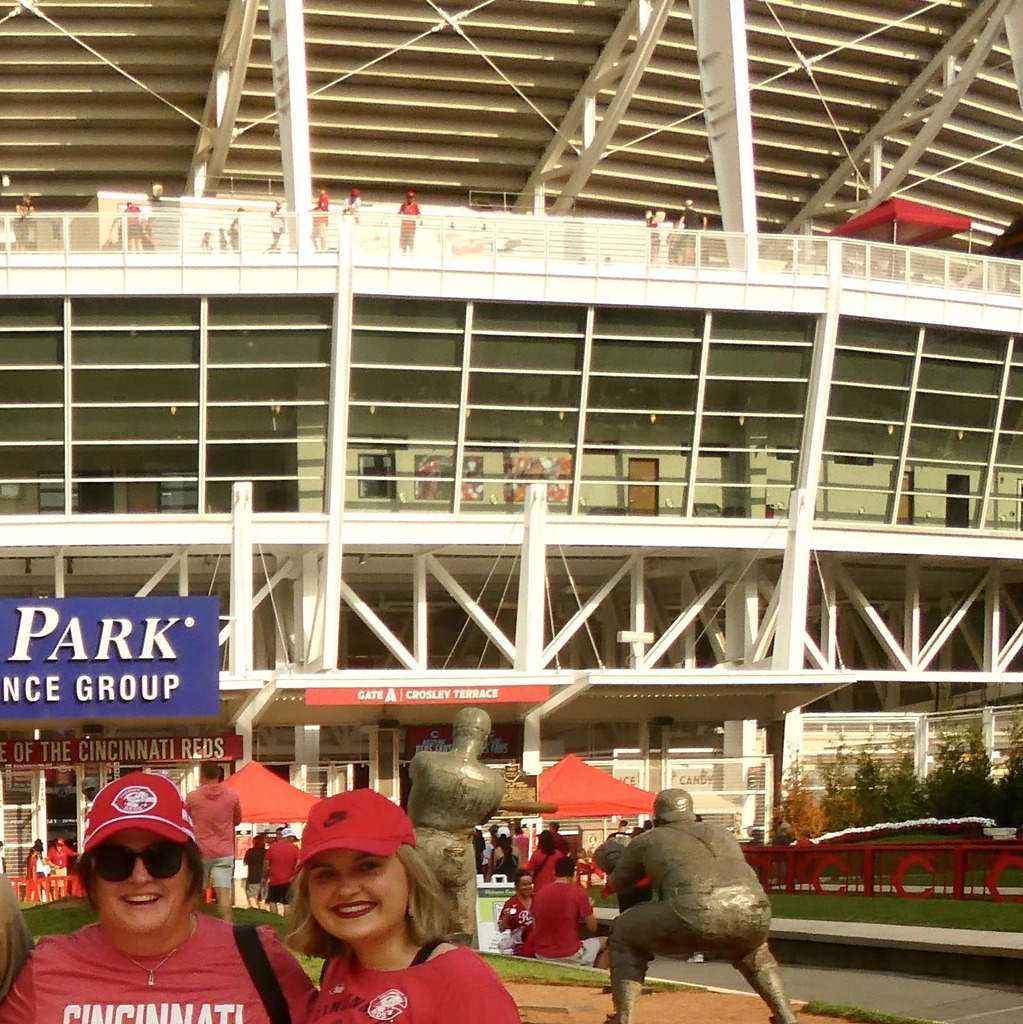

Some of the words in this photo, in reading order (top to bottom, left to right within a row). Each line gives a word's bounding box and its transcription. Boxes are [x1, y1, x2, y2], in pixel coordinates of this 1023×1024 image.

[76, 673, 180, 701] GROUP
[357, 690, 384, 701] GATE
[384, 688, 397, 702] A
[405, 689, 452, 700] CROSLEY
[452, 688, 499, 699] TERRACE
[14, 742, 34, 763] OF
[40, 741, 71, 762] THE
[78, 738, 175, 761] CINCINNATI
[181, 737, 225, 759] REDS
